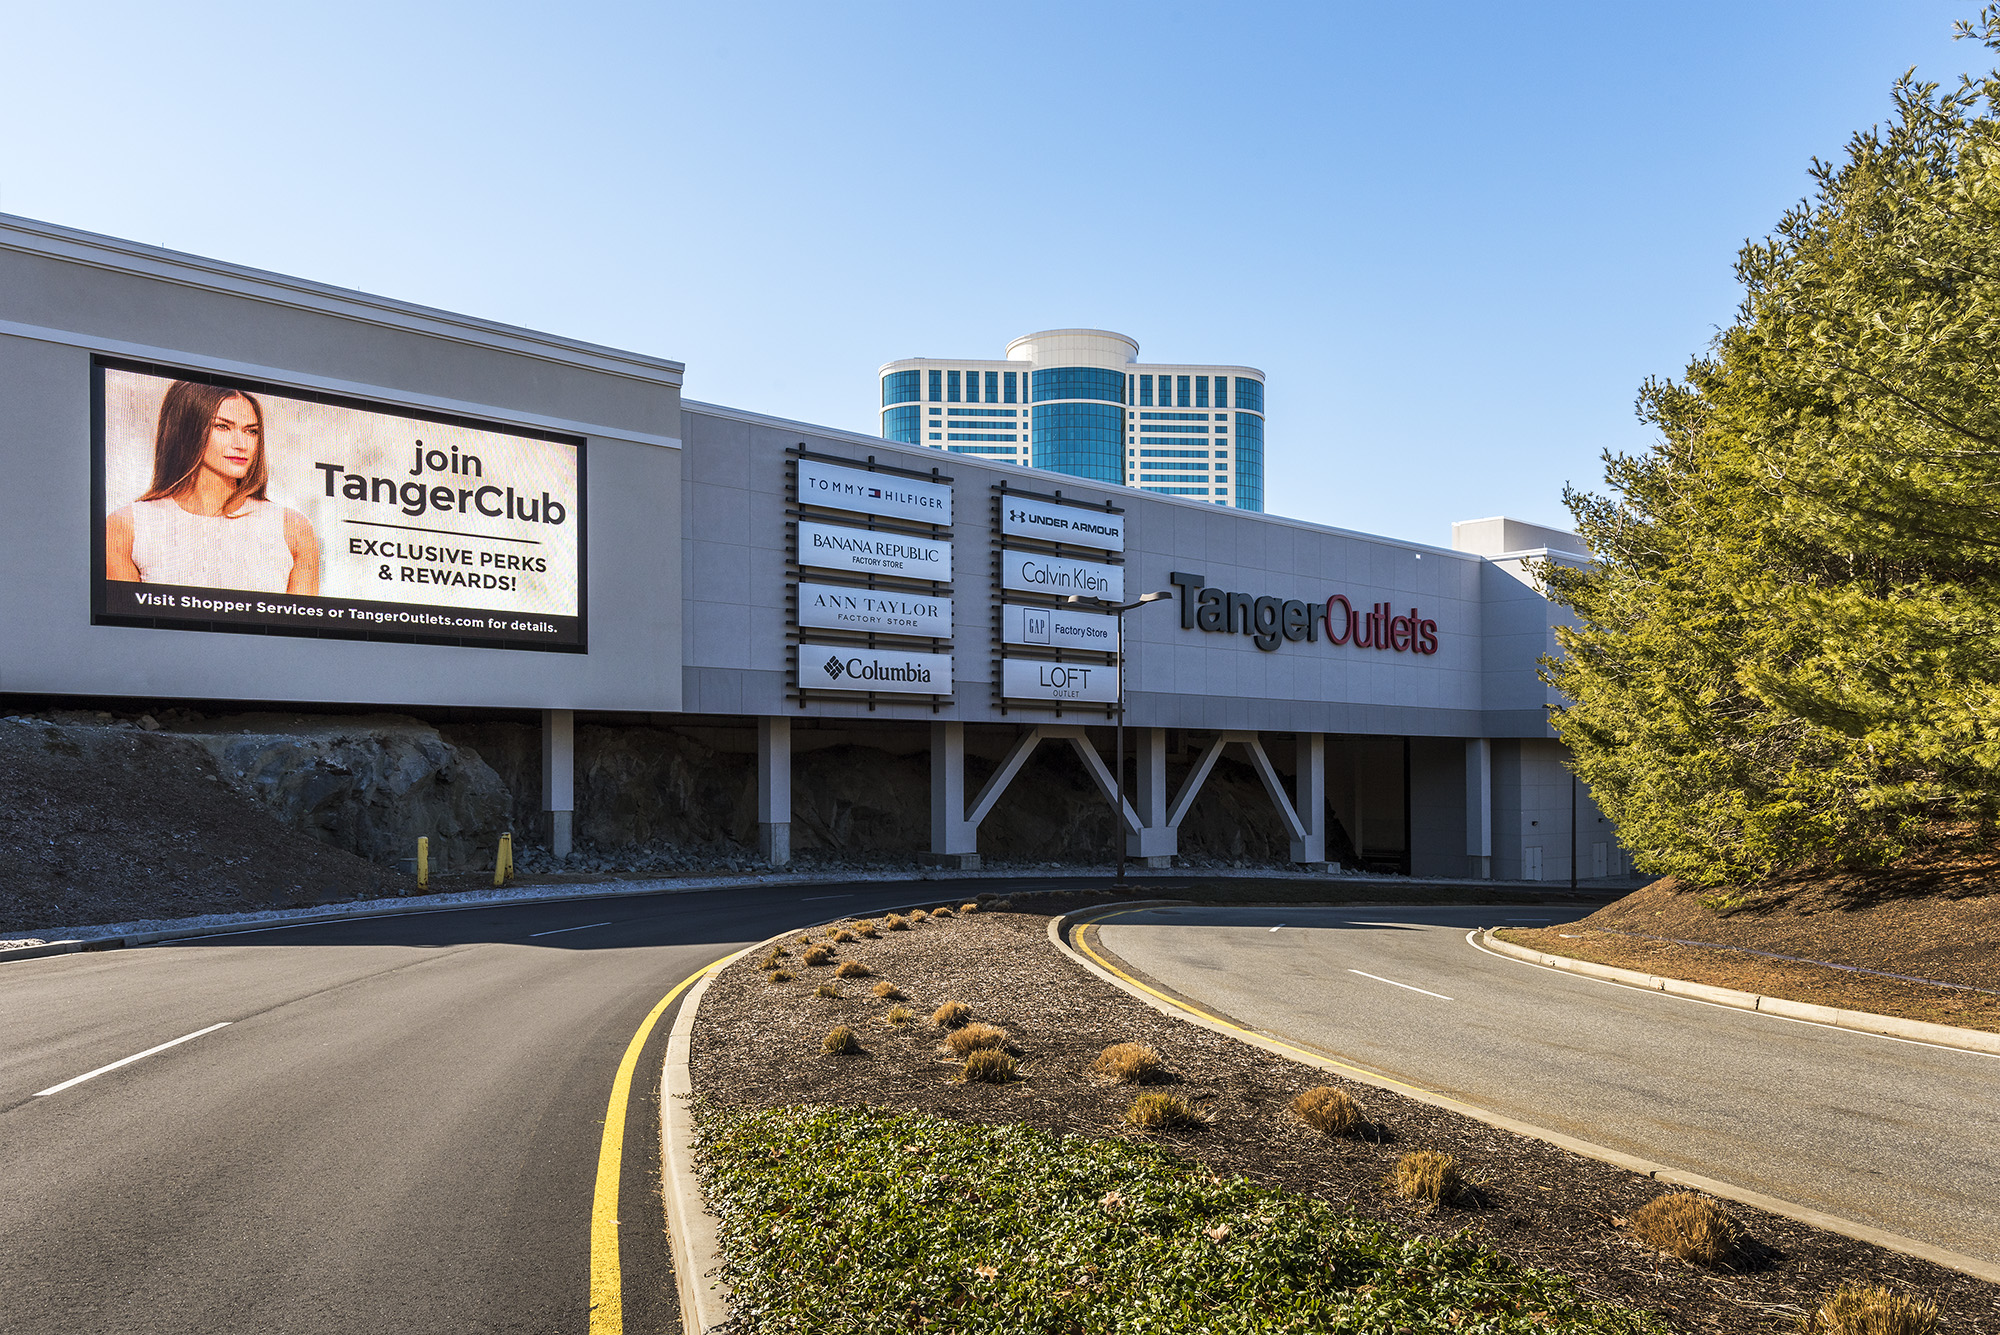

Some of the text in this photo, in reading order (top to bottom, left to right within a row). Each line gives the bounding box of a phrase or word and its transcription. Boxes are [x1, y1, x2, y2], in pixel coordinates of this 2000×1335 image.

[410, 440, 482, 477] join
[315, 461, 566, 525] TangerClub
[809, 477, 943, 510] TOMMY HILFIGER
[1029, 514, 1119, 537] UNDER ARMOUR
[349, 538, 547, 573] EXCLUSIVE PERKS
[813, 533, 939, 563] BANANA REPUBLIC
[852, 556, 903, 569] FACTORY STORE
[378, 564, 517, 592] & REWARDS!
[1022, 561, 1108, 592] Calvin Klein
[135, 592, 558, 633] Visit Shopper Services or TangerOutlets.com for details.
[814, 594, 939, 618] ANN TAYLOR
[837, 613, 918, 627] FACTORY STORE
[1029, 618, 1045, 635] GAP
[1055, 624, 1108, 639] Factory Store
[846, 658, 931, 683] Columbia
[1040, 666, 1091, 689] LOFT
[1053, 689, 1080, 698] OUTLET
